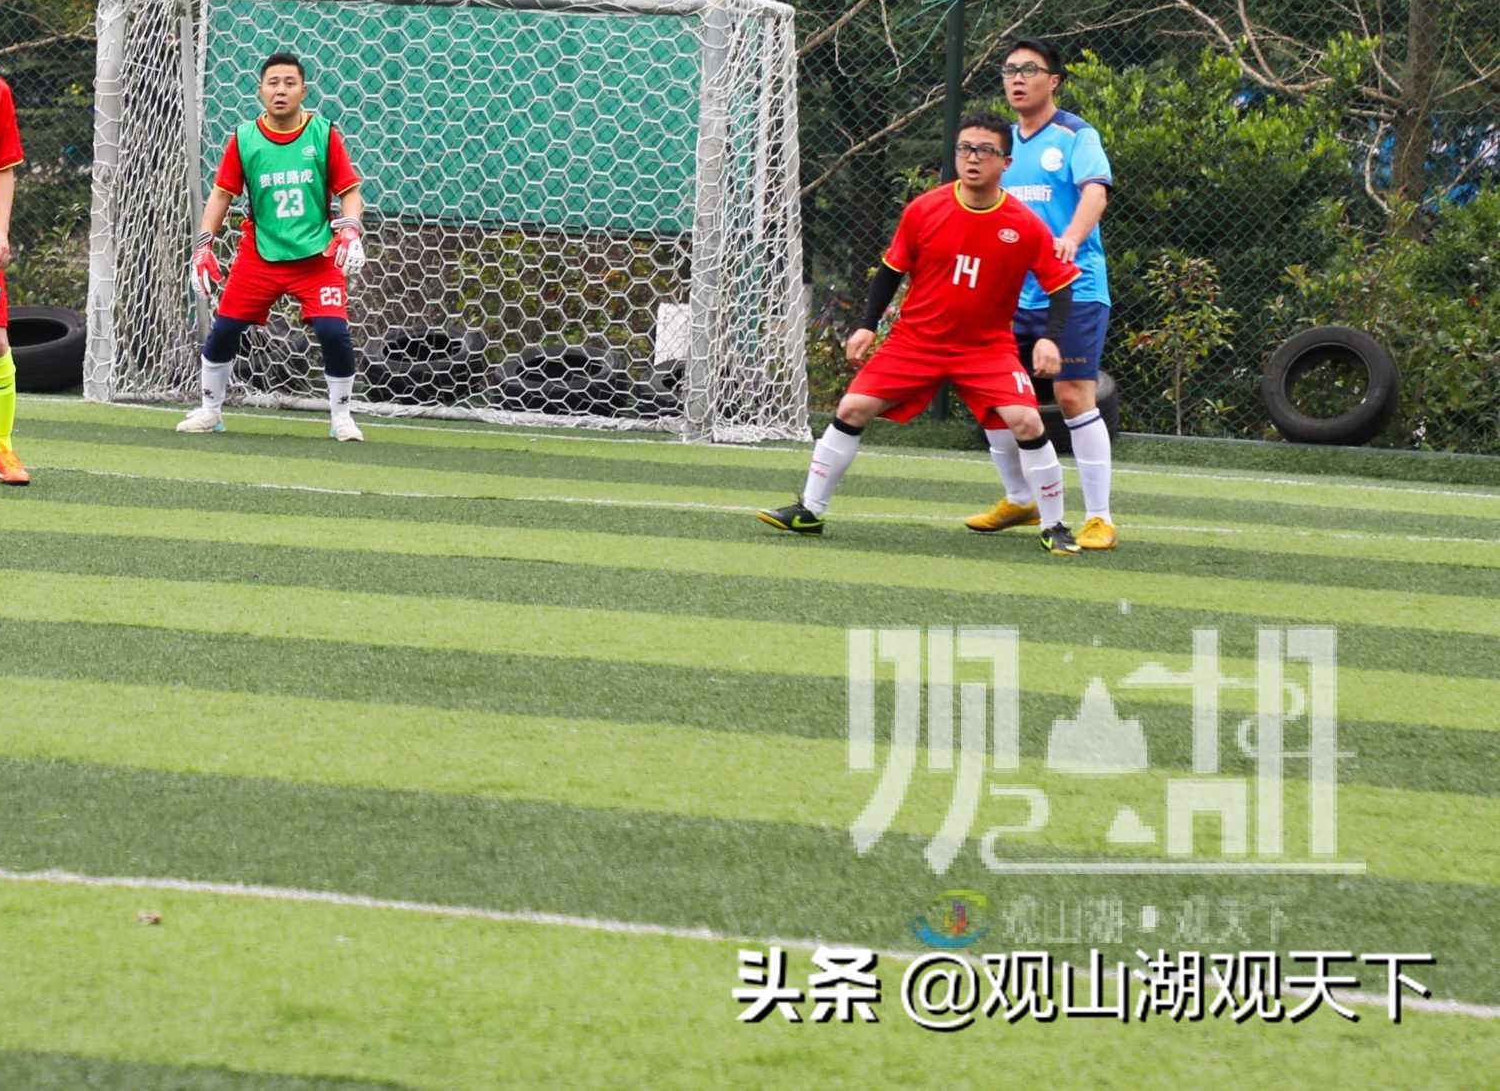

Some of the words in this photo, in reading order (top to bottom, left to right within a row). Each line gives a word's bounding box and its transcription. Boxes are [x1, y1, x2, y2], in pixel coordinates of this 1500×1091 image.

[273, 189, 305, 219] 23
[952, 254, 981, 289] 14
[320, 286, 342, 307] 23
[1012, 371, 1036, 396] 14
